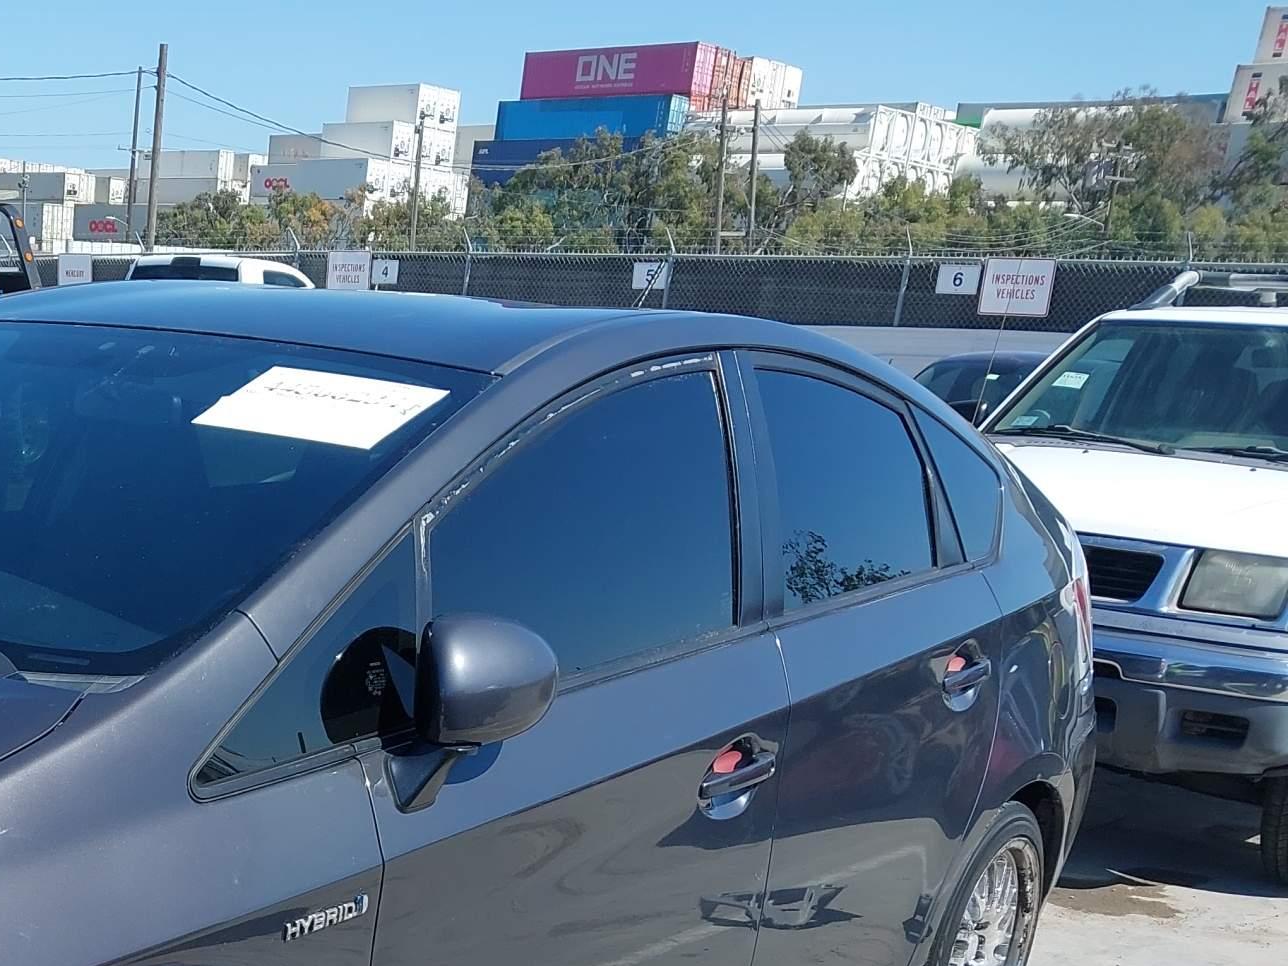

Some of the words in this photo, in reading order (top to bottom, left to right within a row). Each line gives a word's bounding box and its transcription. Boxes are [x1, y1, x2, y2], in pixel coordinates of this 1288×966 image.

[576, 52, 638, 81] ONE
[89, 219, 118, 233] OOCL
[332, 263, 366, 273] INSPECTIONS
[381, 266, 389, 278] 4
[335, 274, 360, 284] VEHICLES
[645, 269, 655, 284] 5
[952, 271, 964, 287] 6
[992, 273, 1046, 286] INSPECTIONS
[996, 288, 1036, 300] VEHICLES
[285, 901, 358, 941] HYBRID
